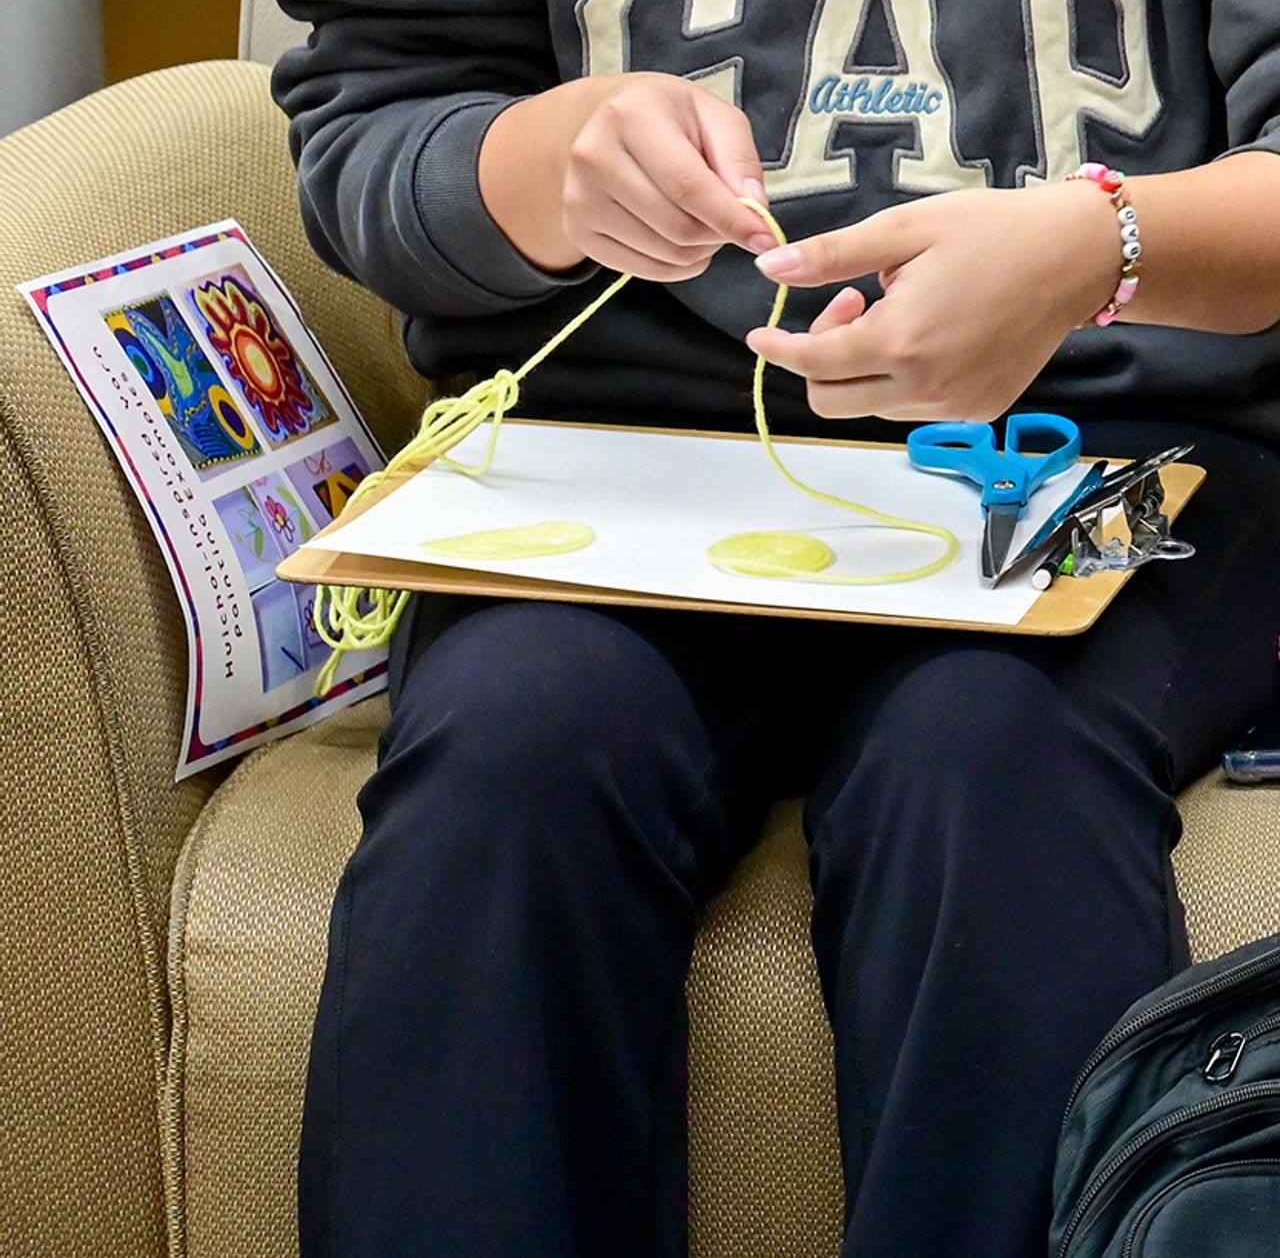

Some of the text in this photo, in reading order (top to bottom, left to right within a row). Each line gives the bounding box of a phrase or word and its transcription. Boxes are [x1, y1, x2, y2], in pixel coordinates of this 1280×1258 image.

[809, 74, 943, 116] Athletic
[93, 345, 131, 410] Yarn
[120, 371, 243, 639] Painting Examples
